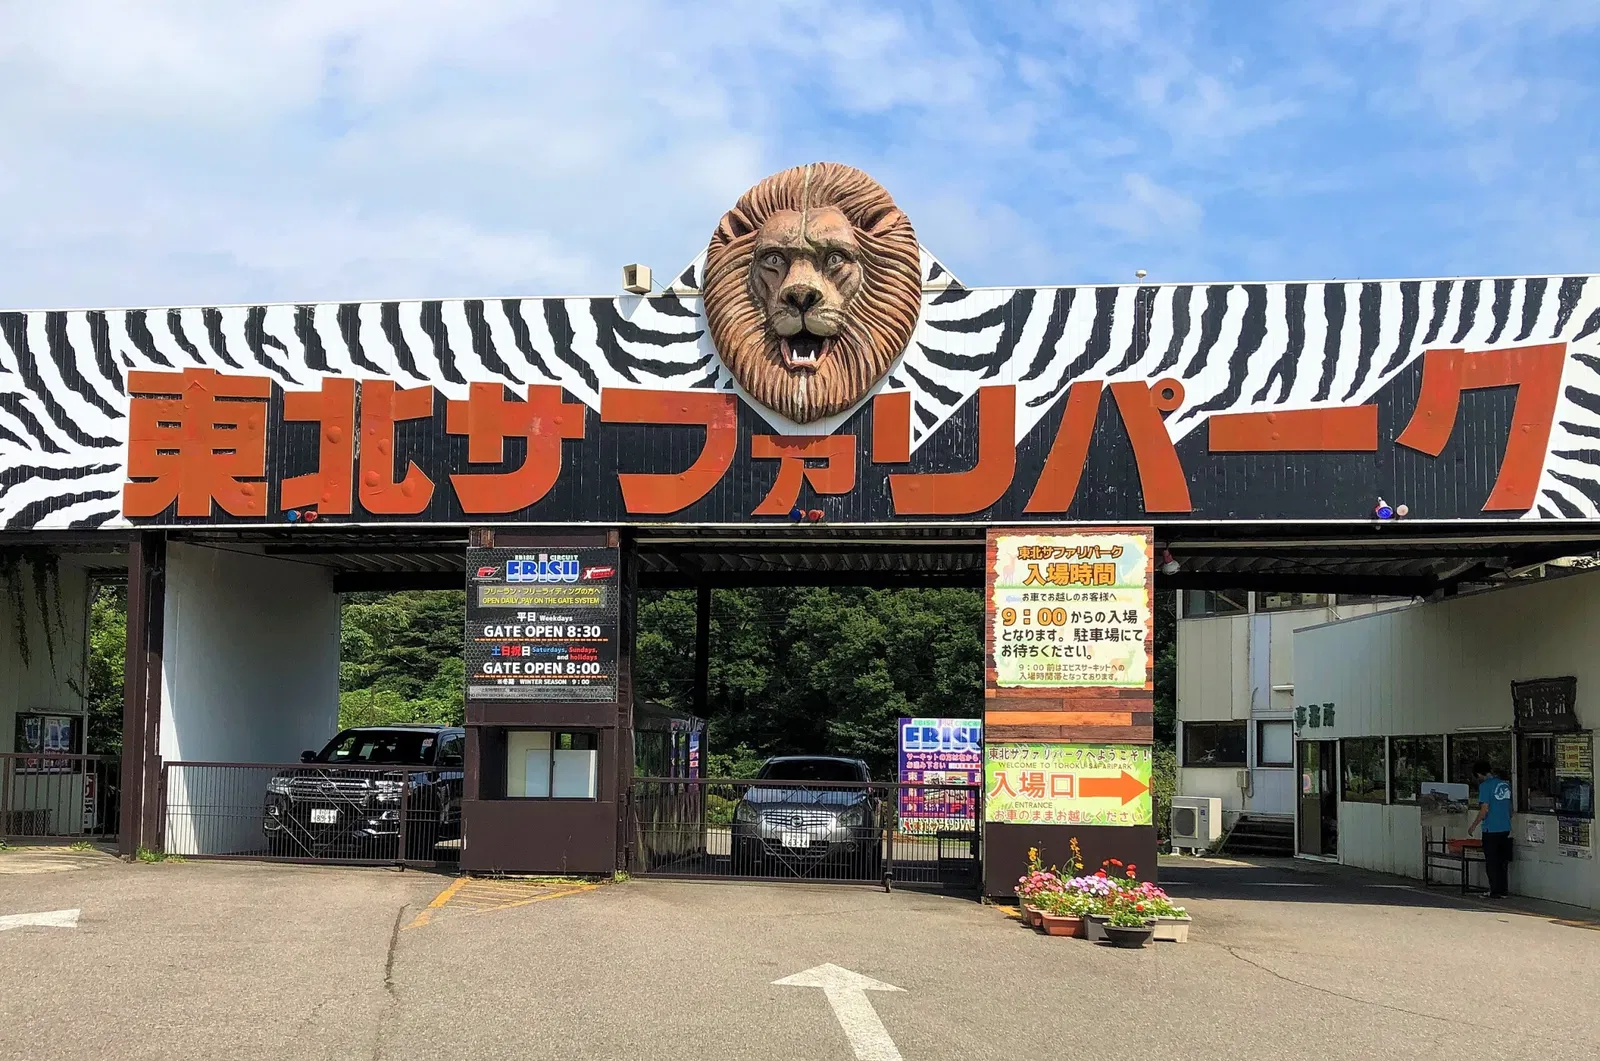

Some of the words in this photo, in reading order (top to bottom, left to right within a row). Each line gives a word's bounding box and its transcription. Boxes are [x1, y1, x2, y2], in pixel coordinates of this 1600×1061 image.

[122, 342, 1567, 518] 東北サファリパーク
[1018, 545, 1123, 560] 東北サファリパーク
[506, 560, 579, 582] EBISU
[1023, 563, 1116, 586] 入場時間
[1022, 592, 1117, 602] お車でお越しのお客様へ
[517, 612, 536, 622] 平日
[1071, 609, 1137, 624] からの入場
[484, 625, 521, 637] GATE
[525, 625, 563, 637] OPEN
[567, 625, 601, 637] 8:30
[491, 646, 530, 656] 土日祝日
[1001, 644, 1092, 660] お待ちください。
[483, 662, 521, 674] GATE
[524, 662, 562, 674] OPEN
[566, 662, 600, 674] 8:00
[1019, 672, 1118, 681] 入場時間帯となっております。
[990, 771, 1074, 798] 入場口
[994, 810, 1143, 823] お車のままお越しください
